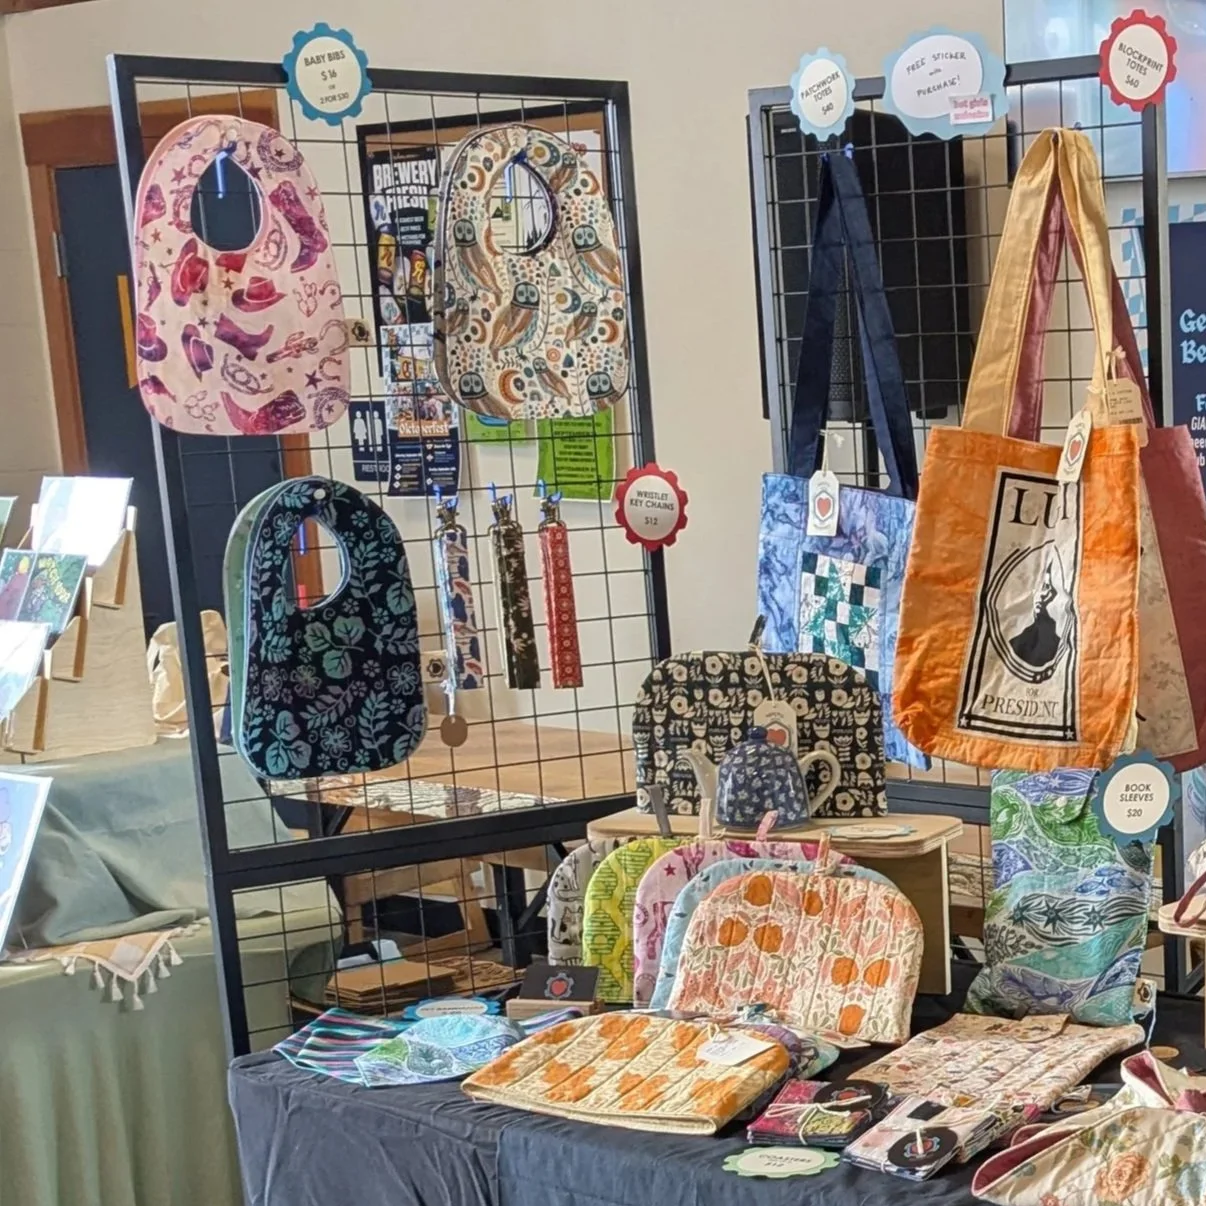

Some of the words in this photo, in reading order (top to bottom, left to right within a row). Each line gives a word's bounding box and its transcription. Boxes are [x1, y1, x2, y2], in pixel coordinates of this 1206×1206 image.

[304, 53, 326, 67] BABY
[327, 50, 346, 62] BIBS
[906, 57, 926, 76] FREE
[932, 52, 967, 62] STICKER
[1119, 42, 1163, 73] BLOCKPRINT
[1126, 58, 1148, 76] TOTES
[801, 71, 840, 99] PATCHWORK
[916, 74, 961, 98] PURCHASE!
[813, 86, 832, 102] TOTES
[373, 159, 436, 193] BREWERY
[636, 490, 669, 501] WRISTLET
[630, 499, 643, 507] KEY
[645, 500, 675, 511] CHAINS
[981, 694, 1060, 718] PRESIDNT
[1124, 784, 1151, 792] BOOK
[1120, 793, 1154, 802] SLEEVES
[1127, 808, 1143, 818] $20
